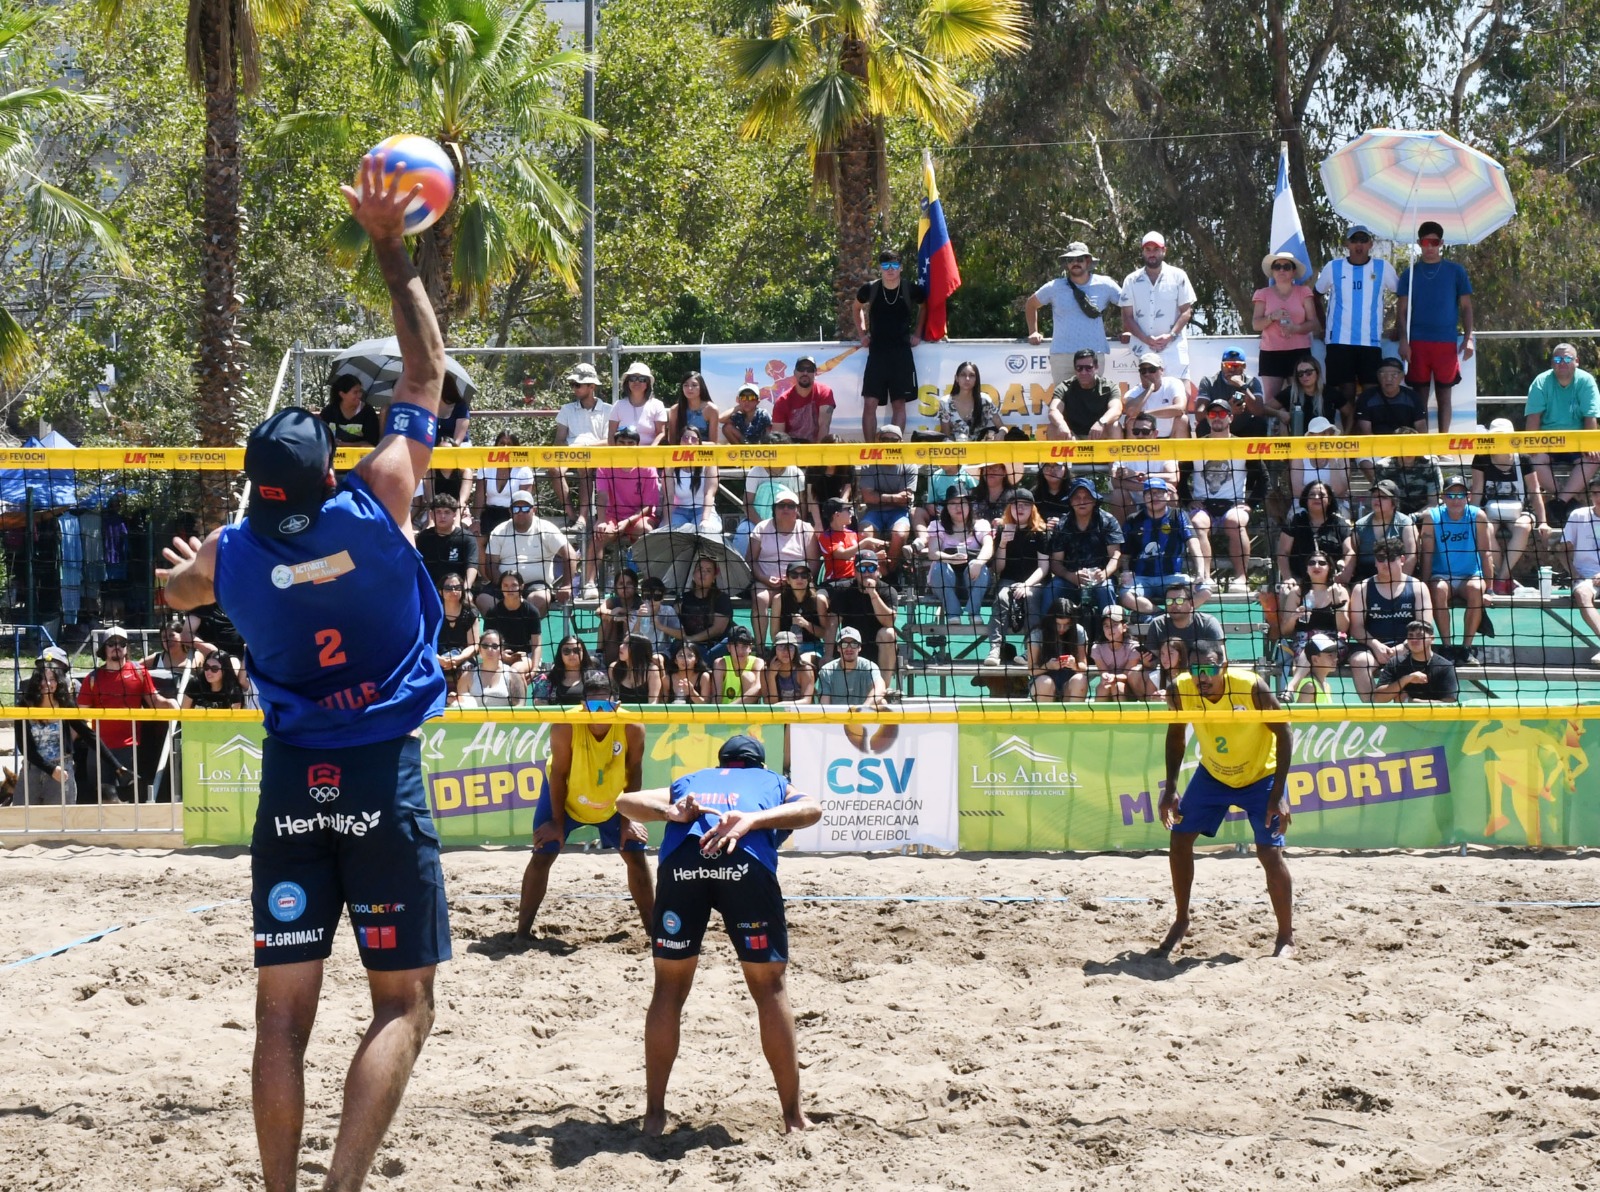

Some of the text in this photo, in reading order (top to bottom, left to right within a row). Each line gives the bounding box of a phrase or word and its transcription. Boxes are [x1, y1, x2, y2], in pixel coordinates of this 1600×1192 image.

[1353, 280, 1363, 291] 10
[1318, 441, 1360, 450] FEVOCHI
[1448, 437, 1476, 450] UK
[1523, 436, 1566, 445] FEVOCHI
[739, 449, 778, 458] FEVOCHI
[859, 448, 884, 460] UK
[928, 447, 967, 456] FEVOCHI
[1050, 445, 1076, 458] UK
[1120, 444, 1160, 453] FEVOCHI
[1246, 442, 1273, 455] UK
[9, 452, 46, 461] FEVOCHI
[124, 452, 148, 464] UK
[189, 452, 226, 461] FEVOCHI
[487, 451, 511, 463] UK
[554, 451, 592, 459] FEVOCHI
[671, 450, 696, 462] UK
[315, 628, 347, 668] 2
[1215, 736, 1229, 754] 2
[198, 762, 232, 781] Los
[826, 757, 916, 795] CSV
[971, 764, 1078, 783] Los Andes
[820, 797, 923, 811] CONFEDERACIÓN
[822, 814, 920, 826] SUDAMERICANA
[831, 829, 911, 841] DE VOLEIBOL
[673, 866, 742, 881] Herbalife
[266, 927, 325, 947] E.GRIMALT
